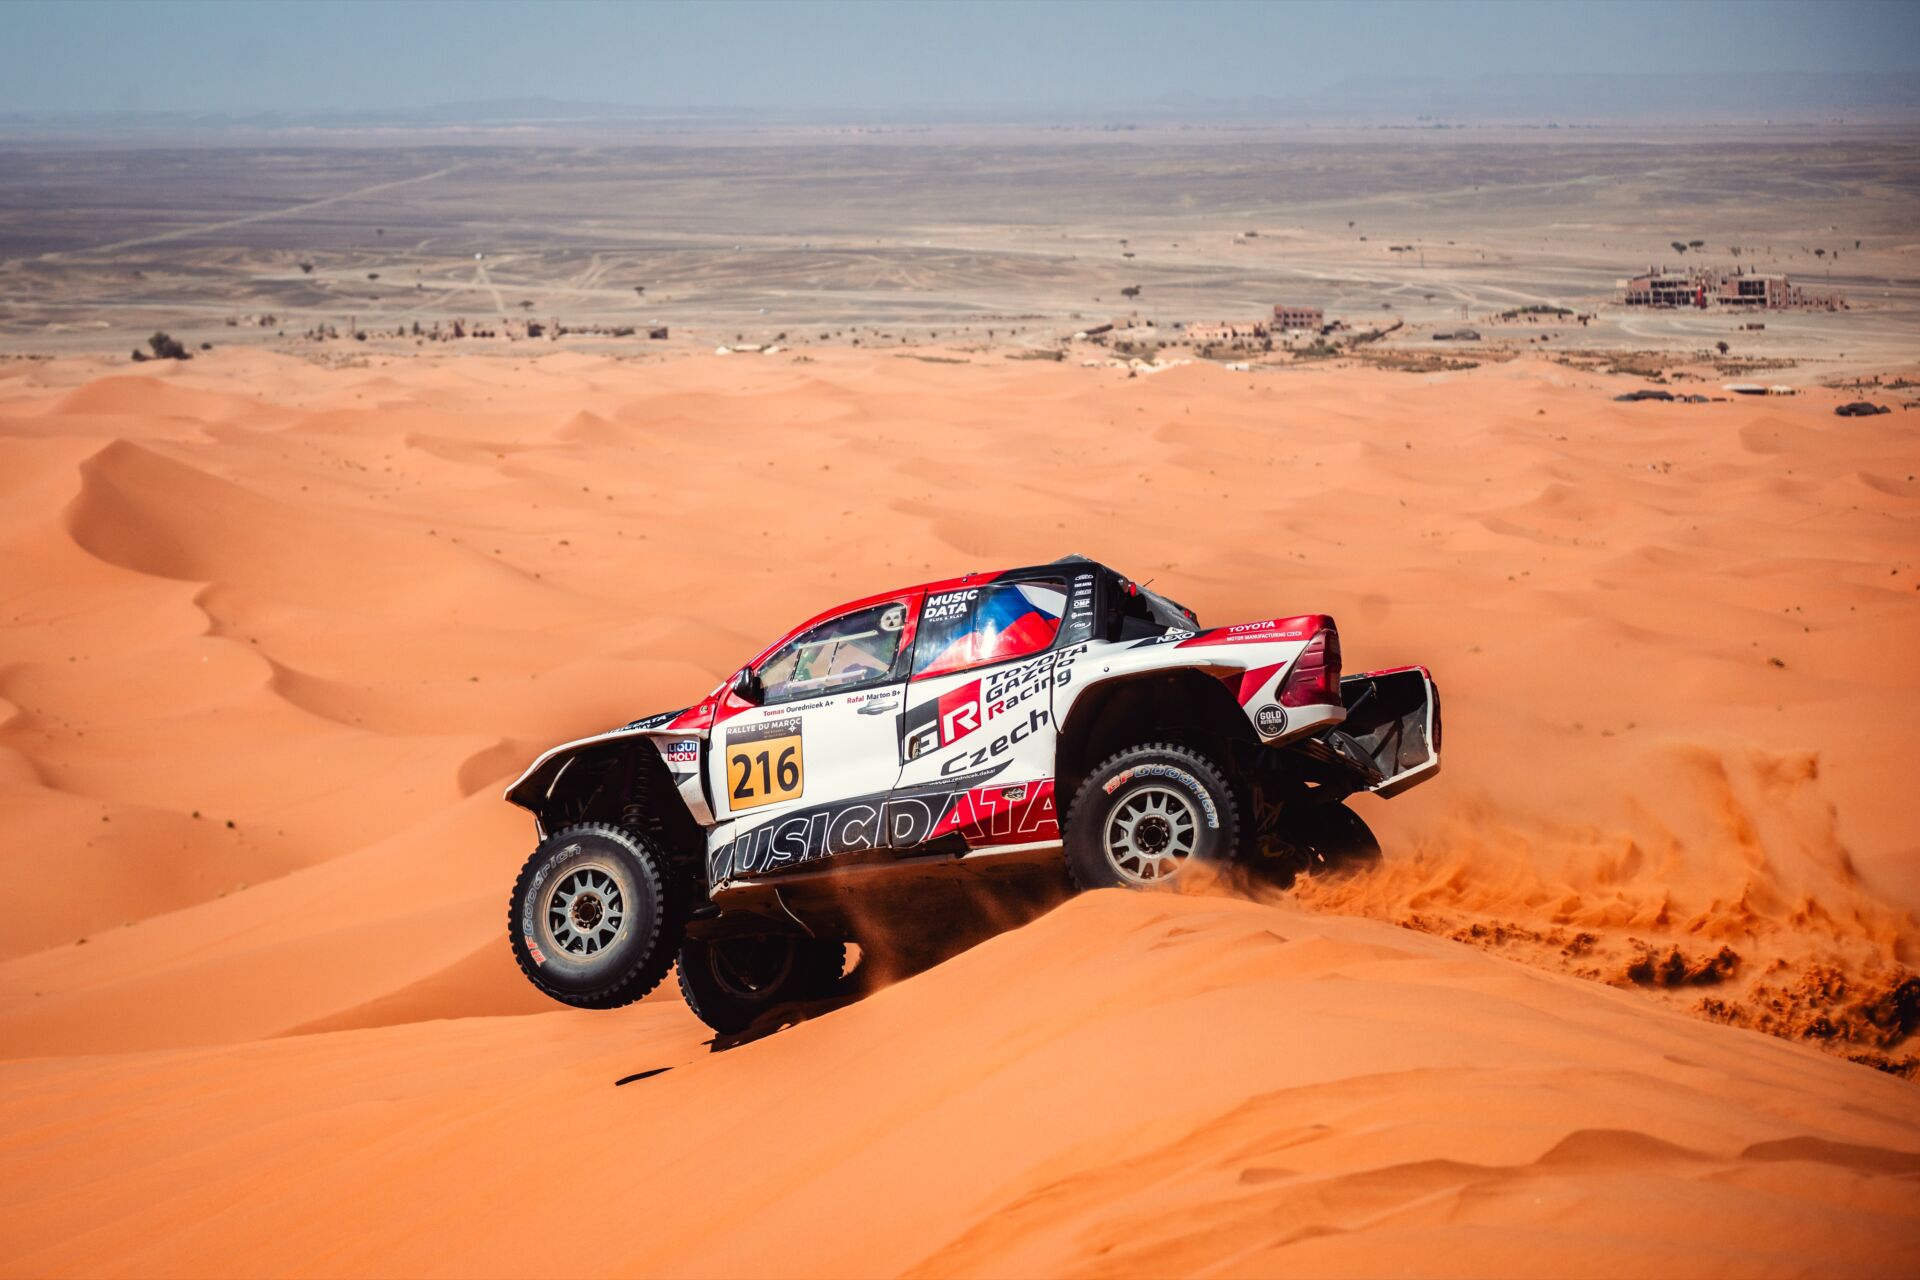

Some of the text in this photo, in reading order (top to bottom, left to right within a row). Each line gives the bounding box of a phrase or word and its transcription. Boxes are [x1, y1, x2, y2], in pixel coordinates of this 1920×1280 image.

[927, 590, 979, 607] MUSIC
[924, 603, 967, 619] DATA
[1228, 621, 1275, 633] TOYOTA
[1245, 632, 1286, 641] MANUFACTURING
[986, 645, 1088, 686] TOYOTA
[986, 658, 1075, 704] GAZOO
[847, 696, 865, 704] Rafal
[866, 692, 891, 700] Marton
[988, 669, 1072, 721] Racing
[763, 709, 785, 717] Tomas
[786, 702, 823, 713] Ourednicek
[1260, 711, 1282, 720] GOLD
[727, 725, 756, 735] RALLYE
[758, 722, 770, 731] DU
[772, 718, 801, 729] MAROC
[668, 743, 696, 752] LIQUI
[941, 709, 1048, 777] Czech
[668, 752, 697, 761] MOLY
[732, 746, 800, 800] 216
